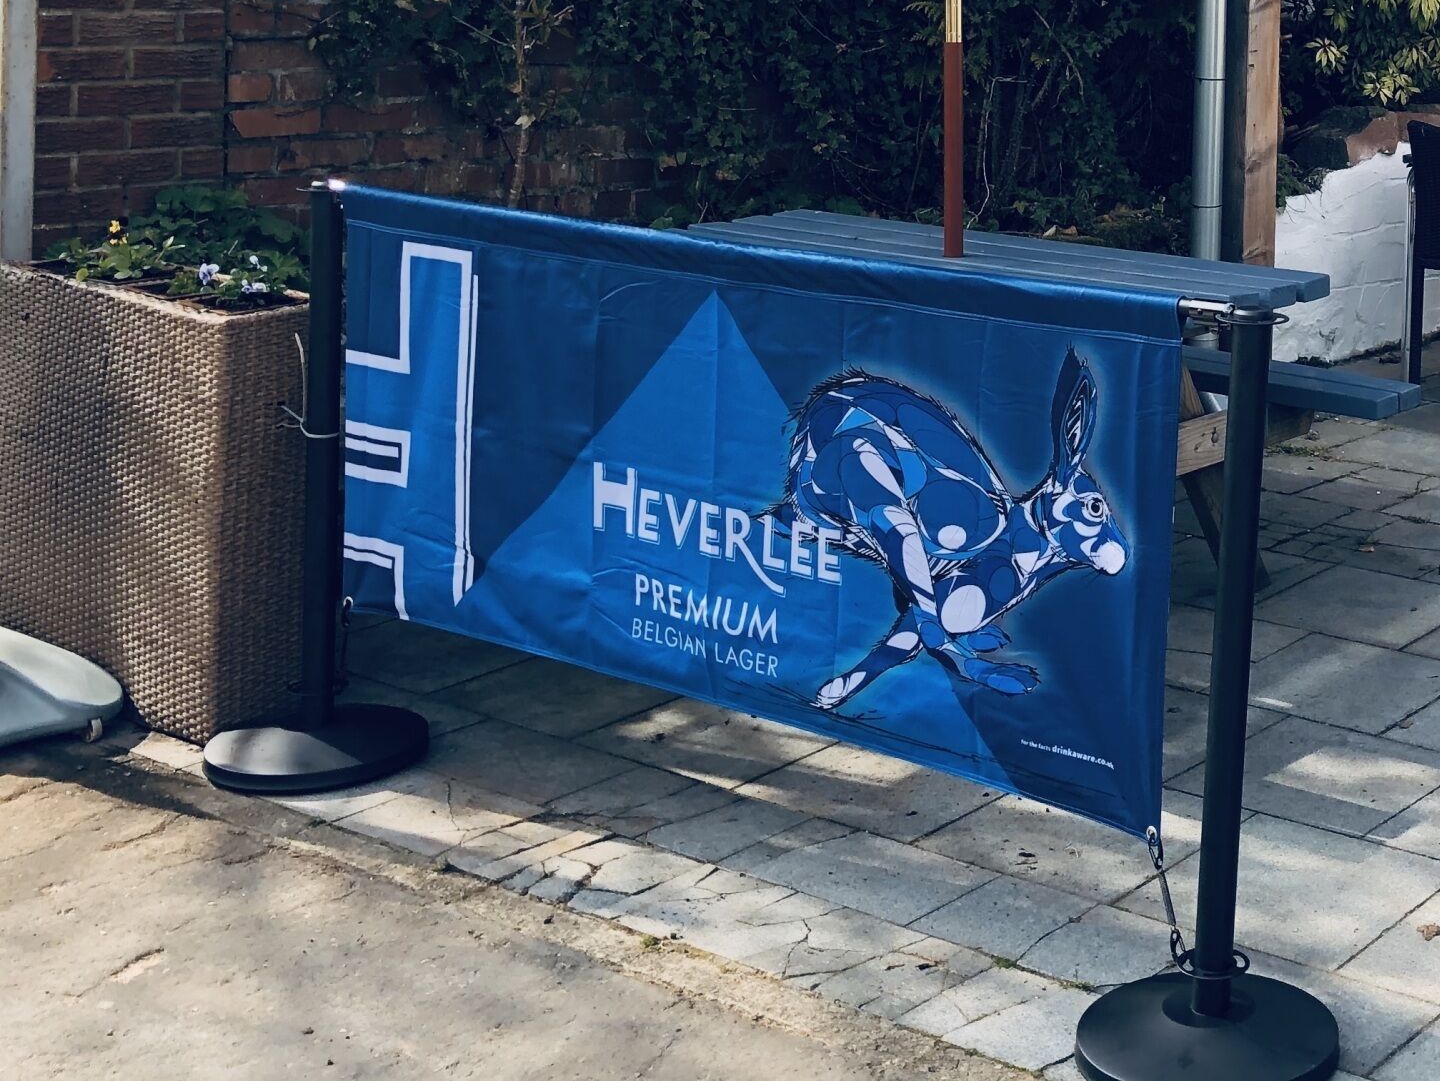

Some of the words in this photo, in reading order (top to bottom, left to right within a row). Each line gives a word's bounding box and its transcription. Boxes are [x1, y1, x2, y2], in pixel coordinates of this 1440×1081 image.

[593, 461, 842, 598] HEVERLEE
[635, 573, 778, 644] PREMIUM
[631, 618, 707, 659] BELGIAN
[714, 642, 779, 678] LAGER
